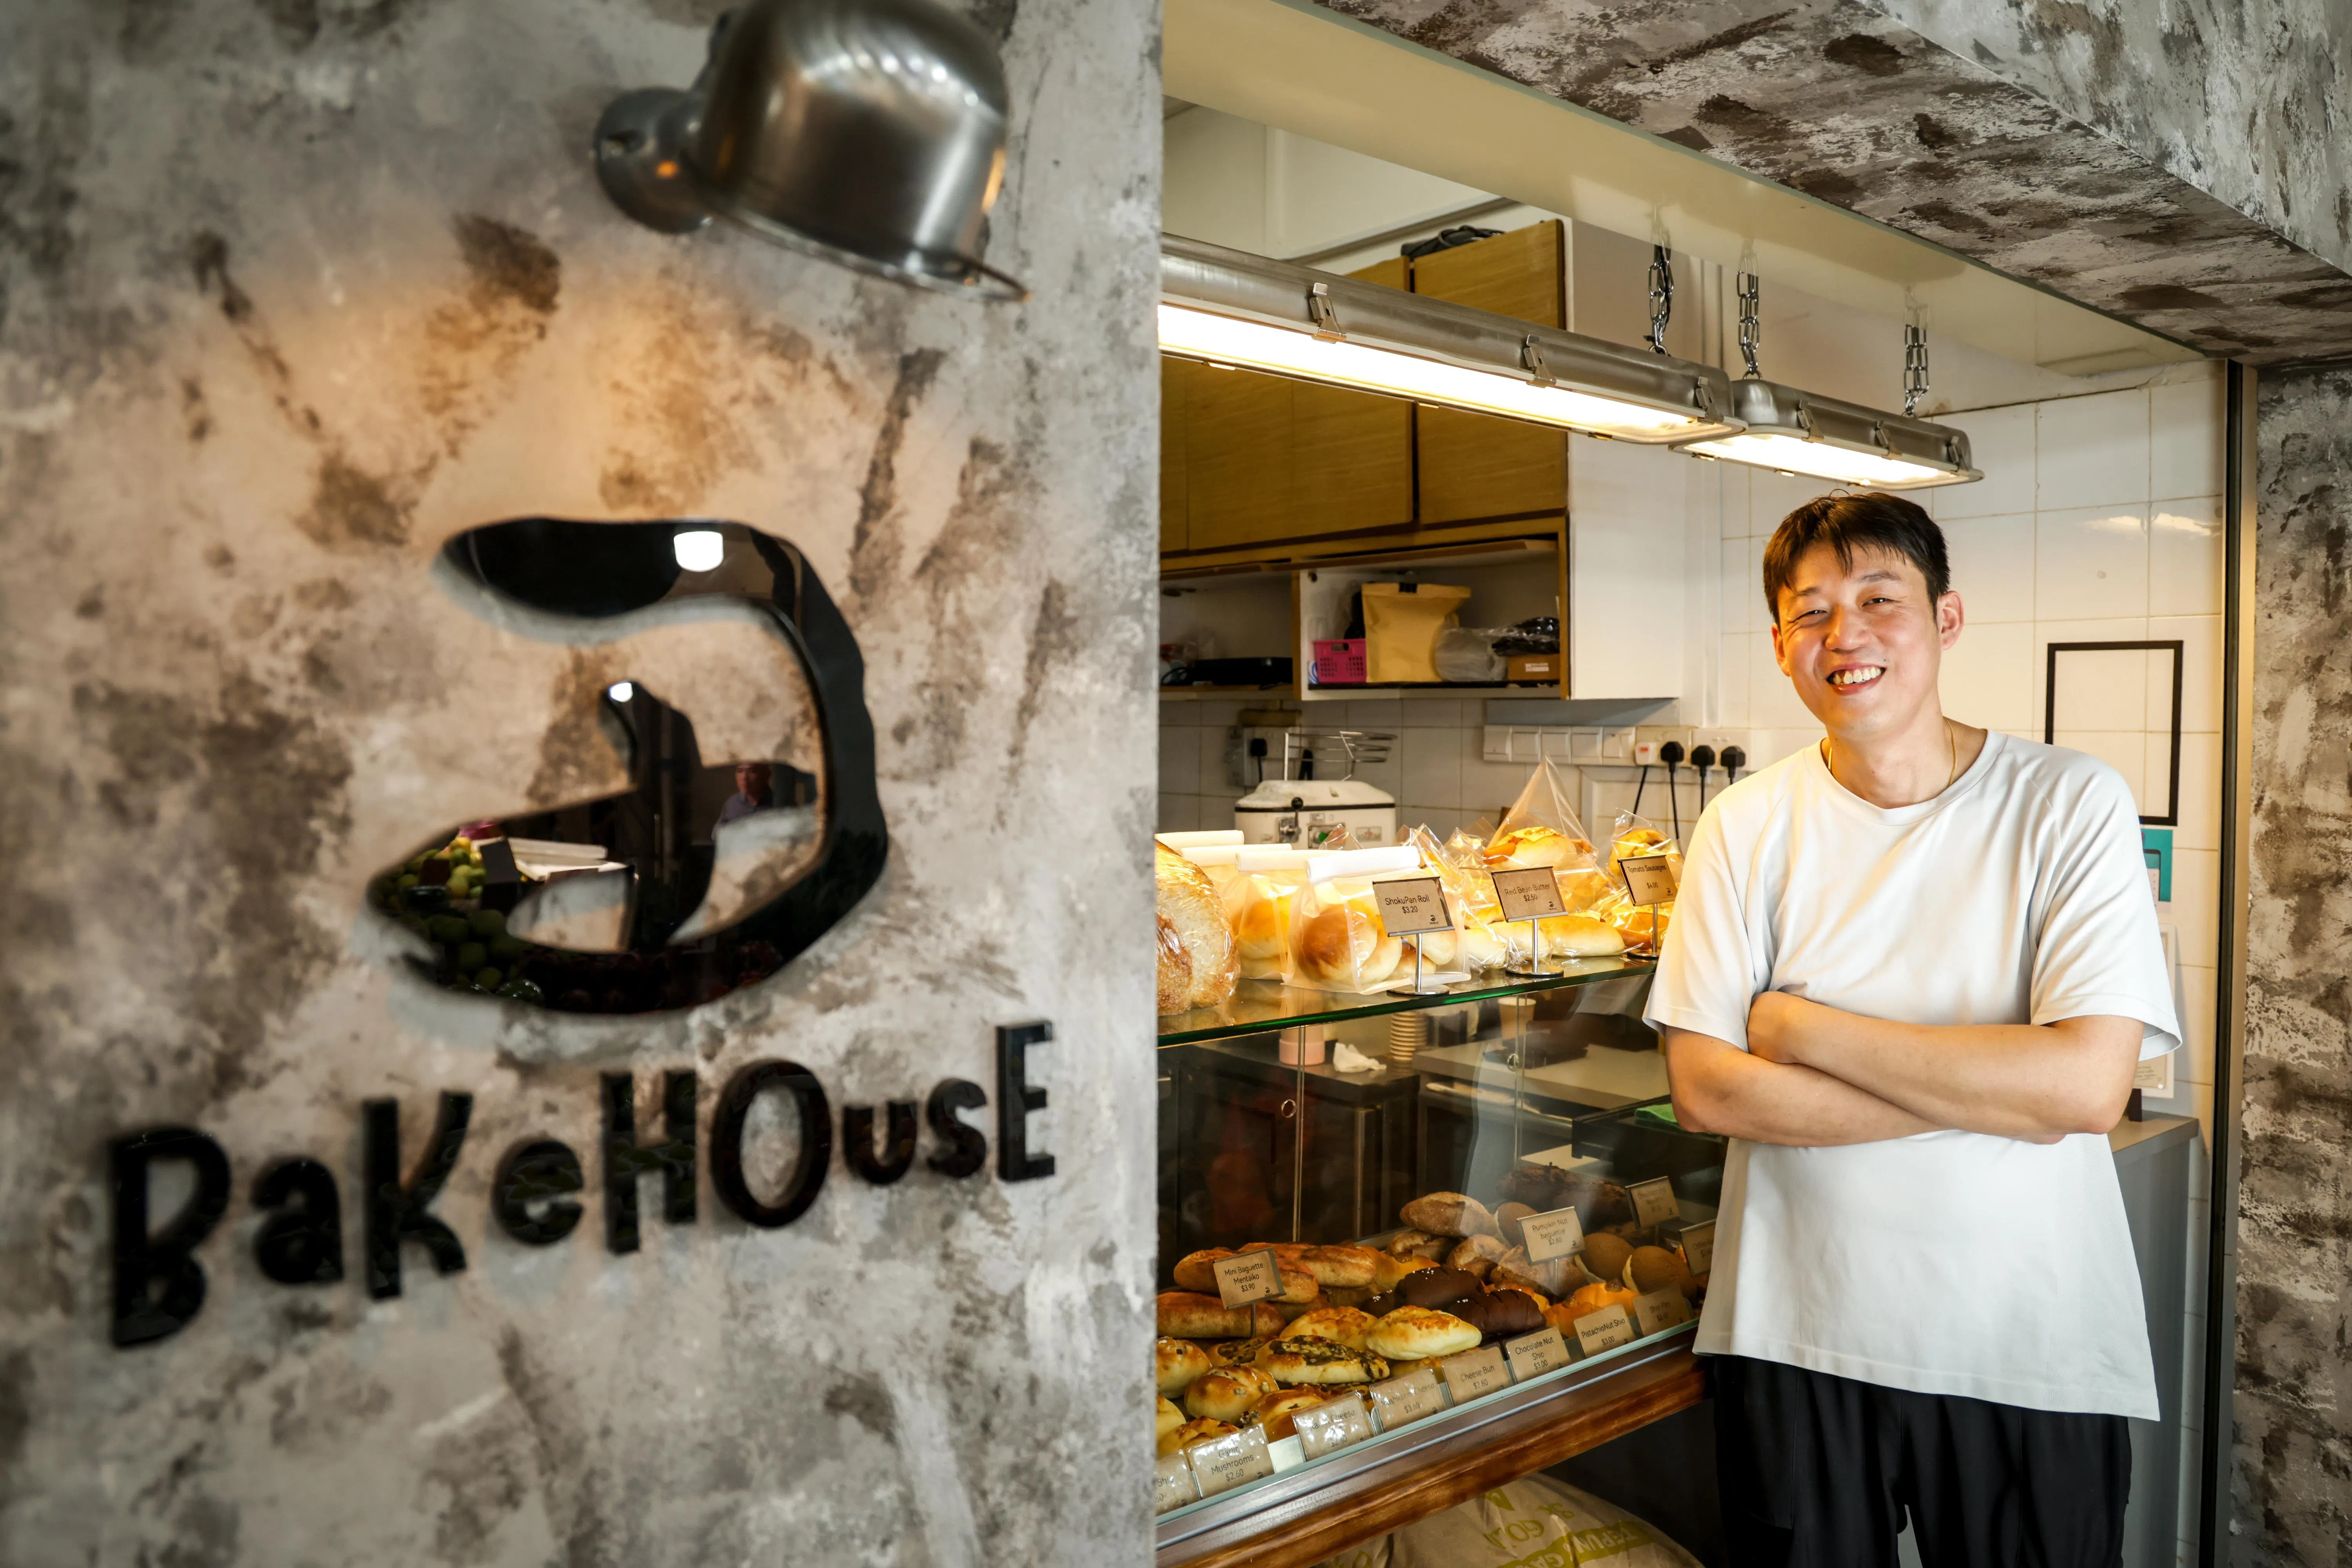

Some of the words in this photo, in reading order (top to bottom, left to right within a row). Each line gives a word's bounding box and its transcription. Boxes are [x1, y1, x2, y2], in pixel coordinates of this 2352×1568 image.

[1385, 896, 1417, 906] ShokuPan
[1523, 894, 1538, 902] $2.50
[1402, 906, 1418, 914] $3.20
[1532, 1221, 1556, 1232] Pumpkin
[1548, 1237, 1563, 1246] $2.80
[1238, 1262, 1263, 1274] Baguette
[1233, 1274, 1259, 1285] Mentaiko
[1241, 1283, 1255, 1292] $3.90
[1581, 1321, 1614, 1339] PistachioNut
[1613, 1318, 1625, 1327] Shio
[1515, 1341, 1543, 1355] Chocolate
[1543, 1336, 1554, 1345] Nut
[1602, 1336, 1615, 1346] $3.00
[1532, 1352, 1544, 1361] Shio
[1534, 1359, 1548, 1370] $3.00
[1460, 1369, 1482, 1381] Cheese
[1482, 1365, 1495, 1374] Bun
[1414, 1383, 1434, 1395] Cheese
[1473, 1379, 1488, 1390] $2.80
[1404, 1401, 1420, 1414] $3.60
[1330, 1409, 1355, 1423] Cheese
[1218, 1446, 1240, 1458] Garlic
[1210, 1454, 1254, 1475] Mushrooms
[1225, 1468, 1244, 1482] $2.60
